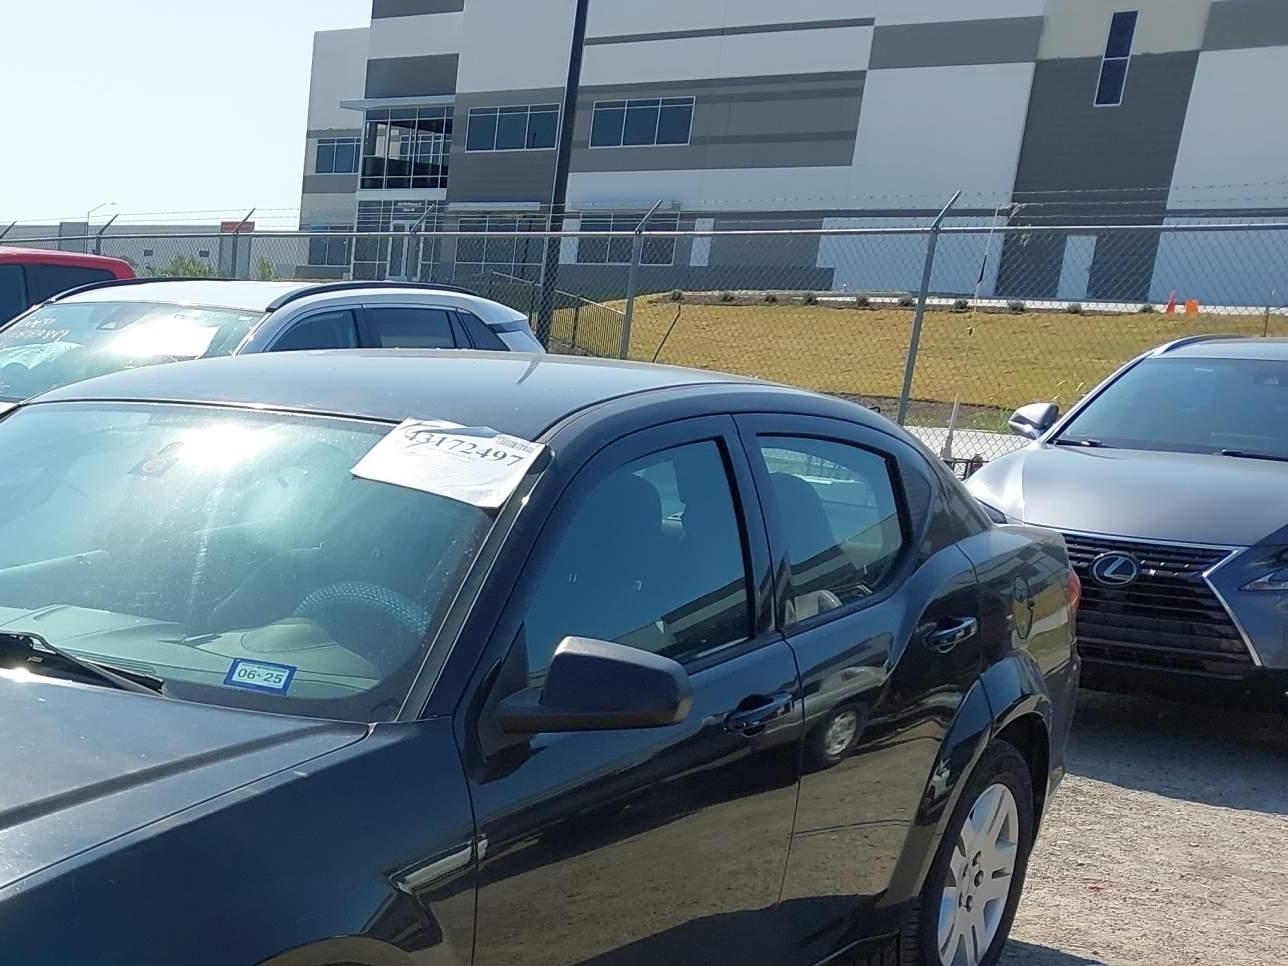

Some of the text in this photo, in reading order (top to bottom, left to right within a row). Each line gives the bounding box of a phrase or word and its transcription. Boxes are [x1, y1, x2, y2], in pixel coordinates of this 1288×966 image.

[404, 430, 524, 467] 43172497
[237, 668, 284, 684] 06 25
